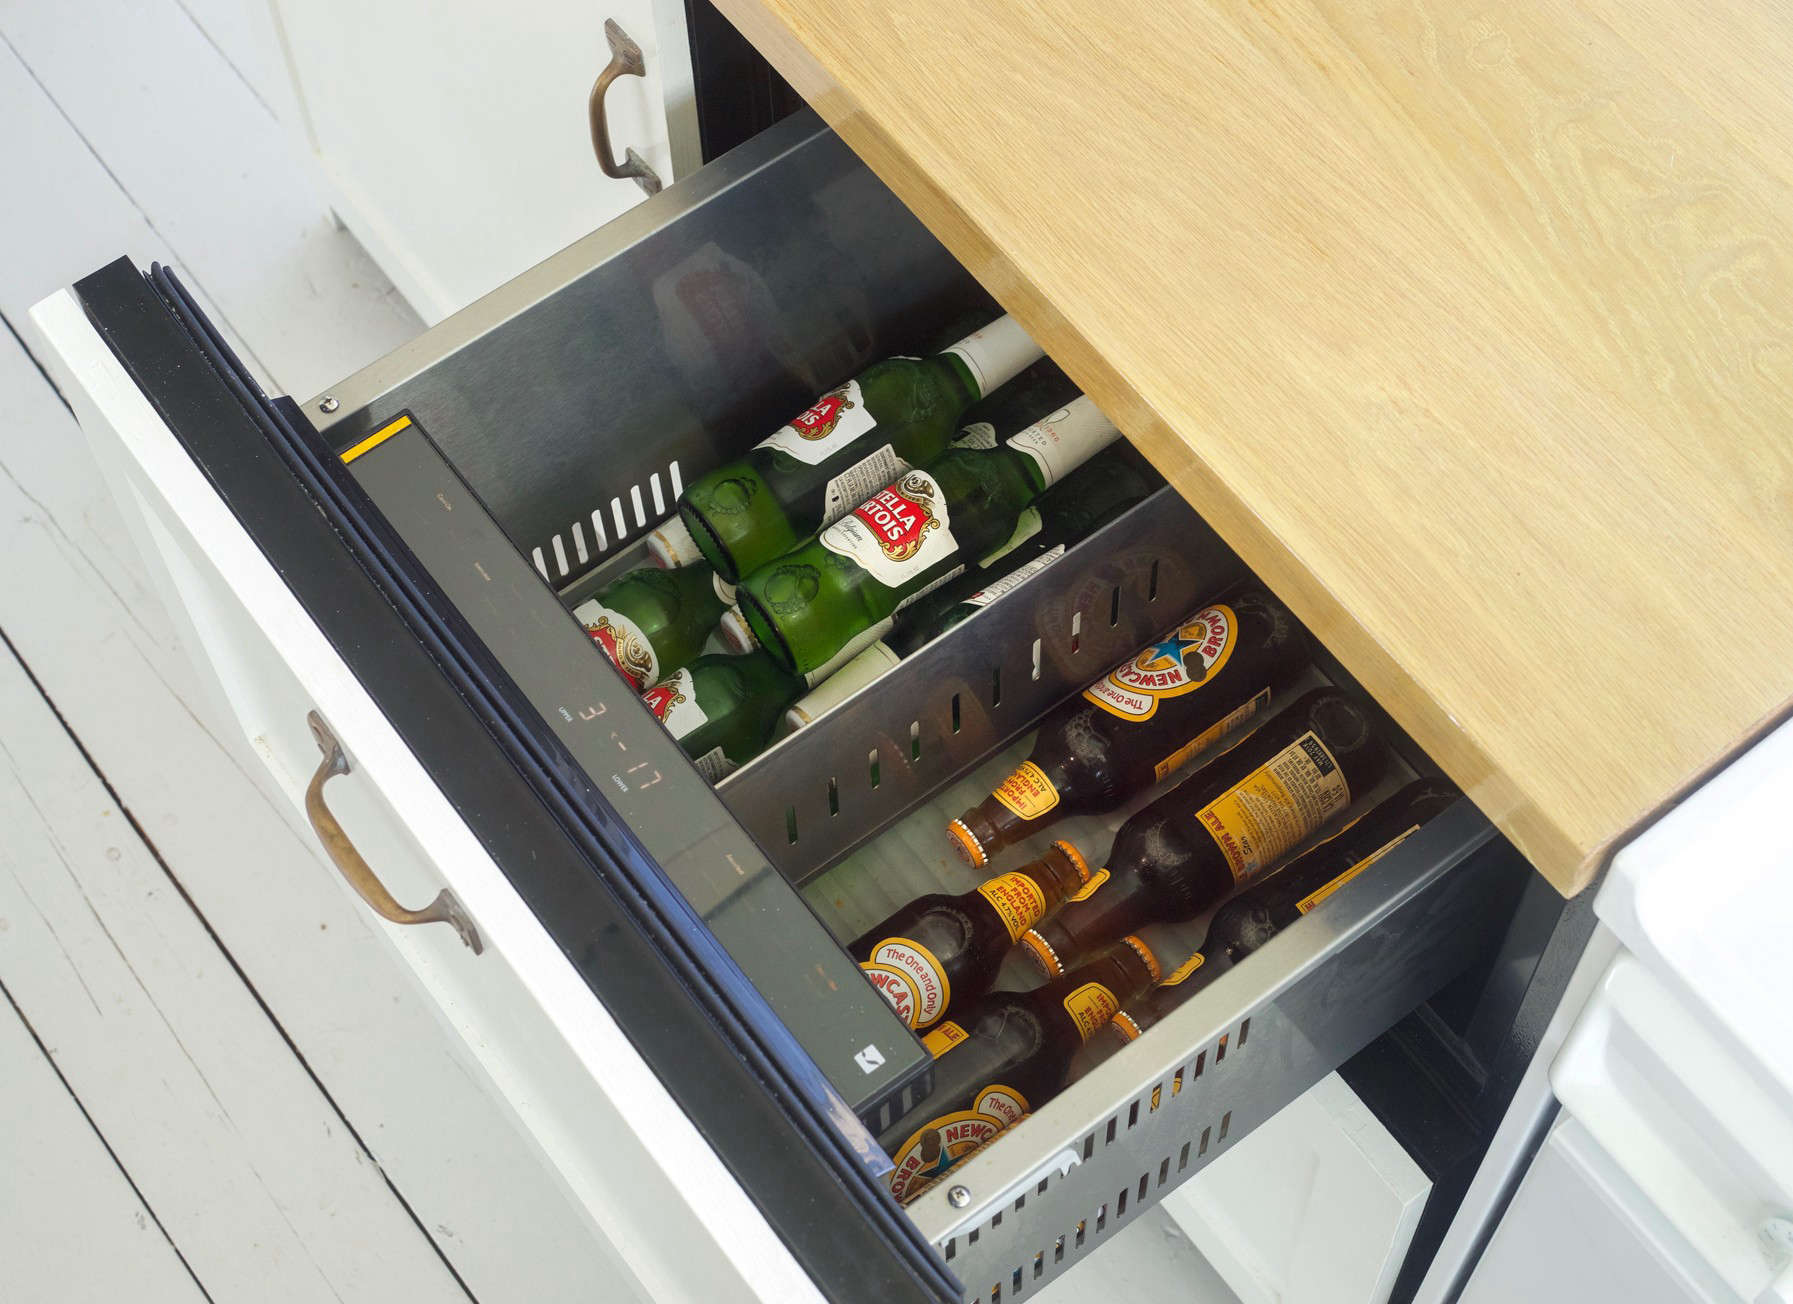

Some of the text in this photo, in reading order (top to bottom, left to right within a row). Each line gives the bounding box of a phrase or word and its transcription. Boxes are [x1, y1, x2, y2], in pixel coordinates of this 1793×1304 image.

[860, 500, 904, 541] RTOIS
[872, 490, 916, 531] TELLA
[579, 702, 607, 720] 3
[1125, 696, 1144, 711] The
[1204, 810, 1225, 832] ALE
[990, 890, 1003, 902] ALC
[996, 886, 1027, 926] ENGLAND
[1010, 877, 1041, 917] IMPORTED
[1011, 887, 1030, 913] FROM
[887, 948, 937, 1015] The One and Only
[990, 1097, 1004, 1111] The
